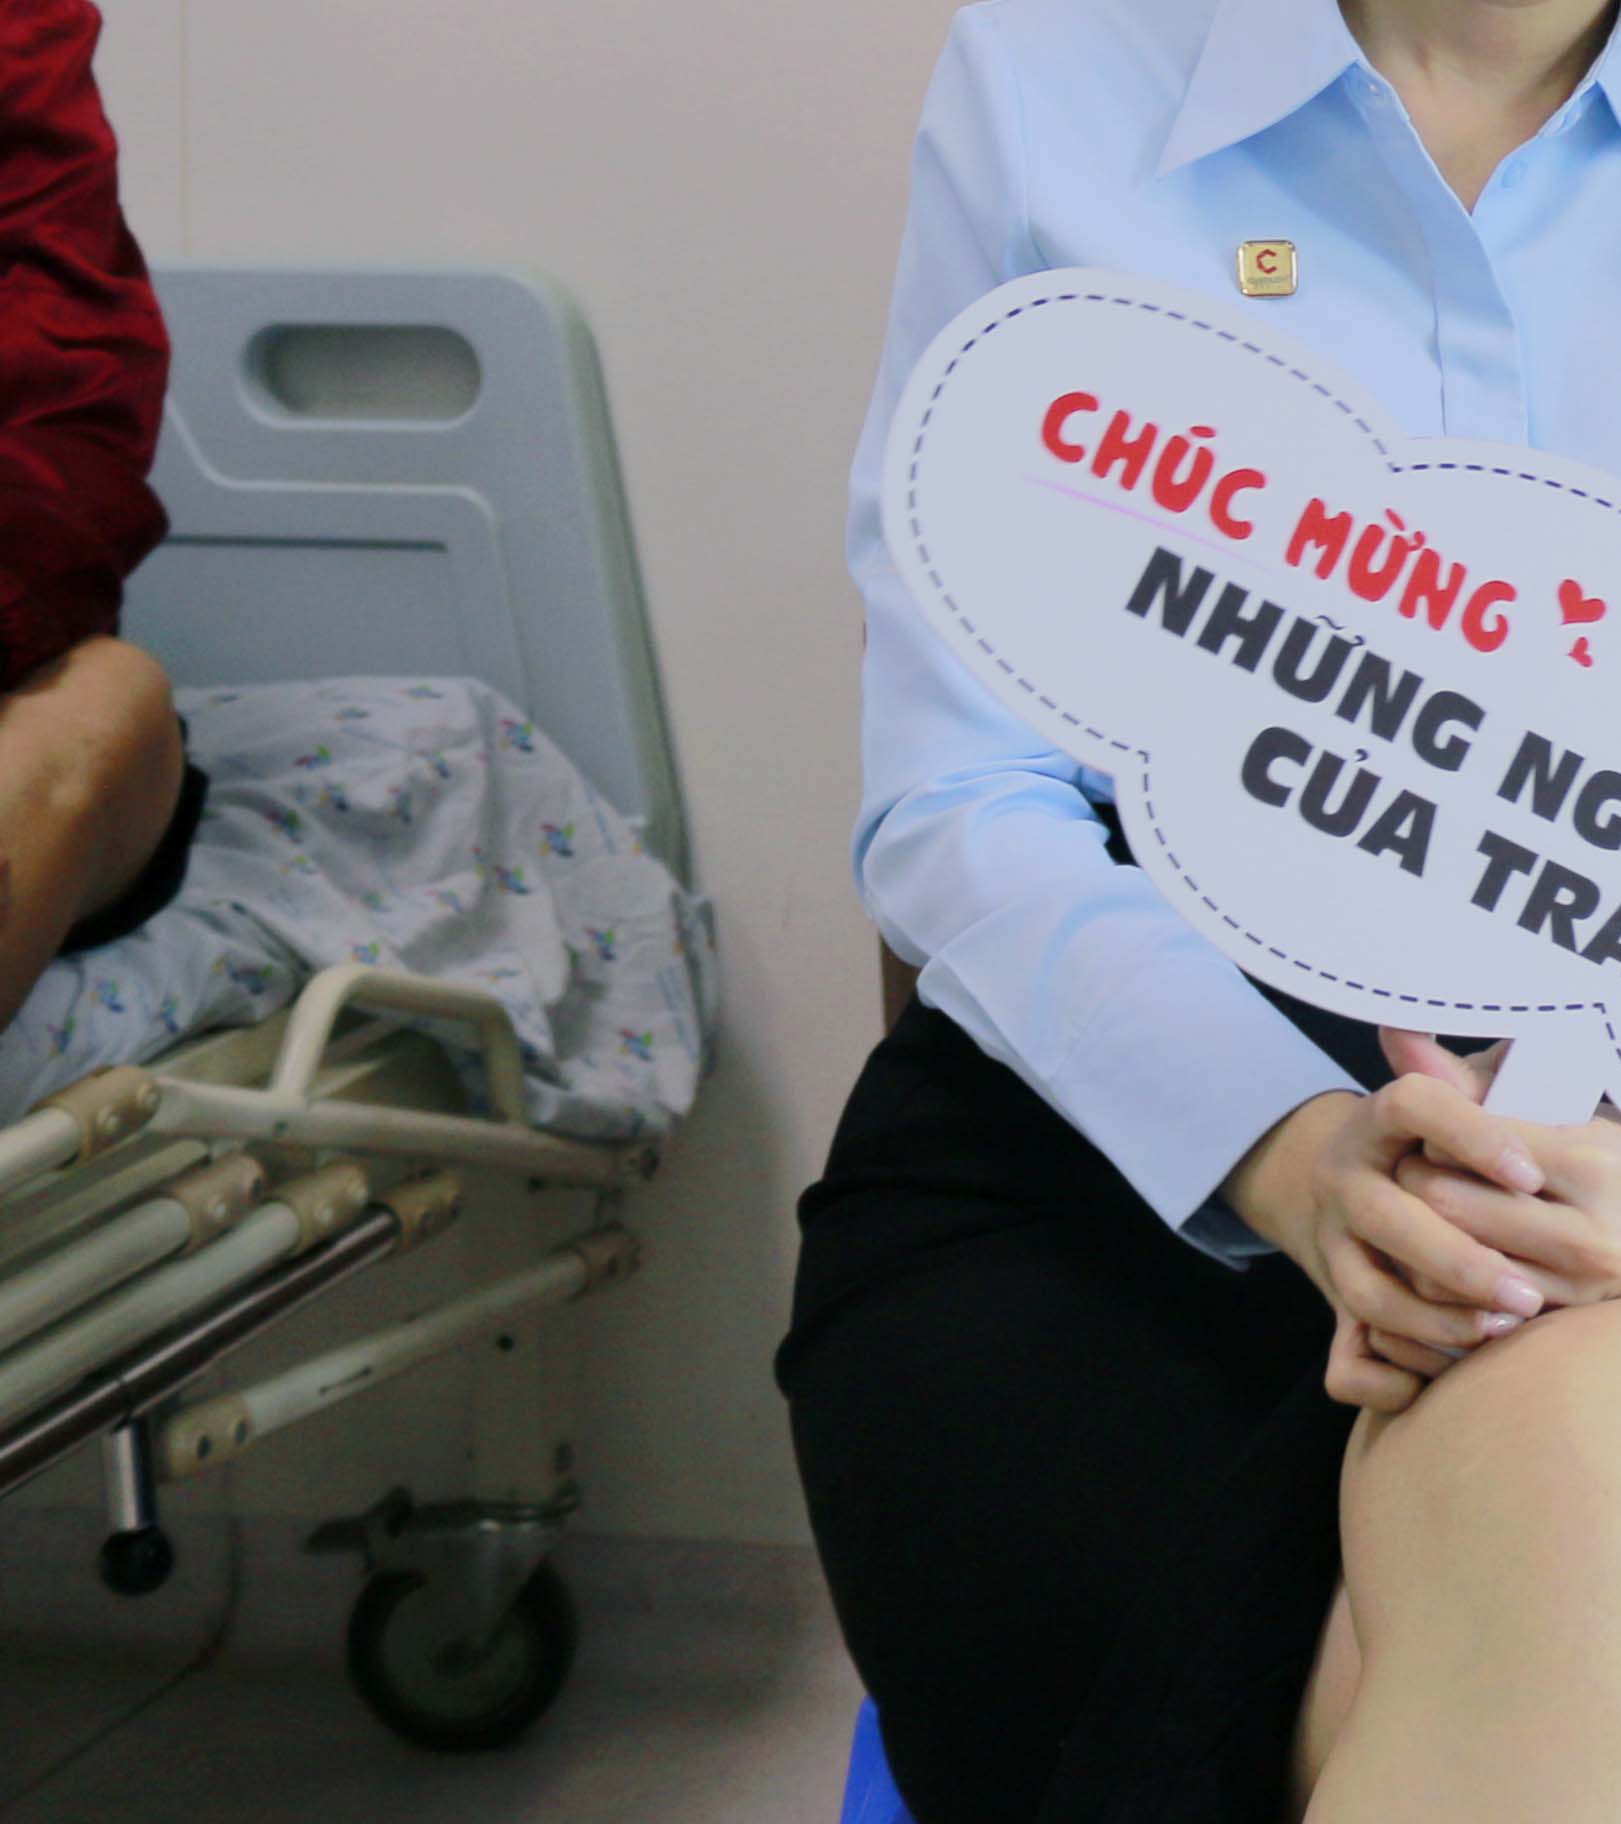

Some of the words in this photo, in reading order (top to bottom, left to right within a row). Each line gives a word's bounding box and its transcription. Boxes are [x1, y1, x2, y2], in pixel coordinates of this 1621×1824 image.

[1039, 389, 1269, 543] CHÚC
[1283, 497, 1522, 654] MỪNG
[1123, 544, 1487, 774] NHỮNG
[1239, 725, 1438, 878] CỦA
